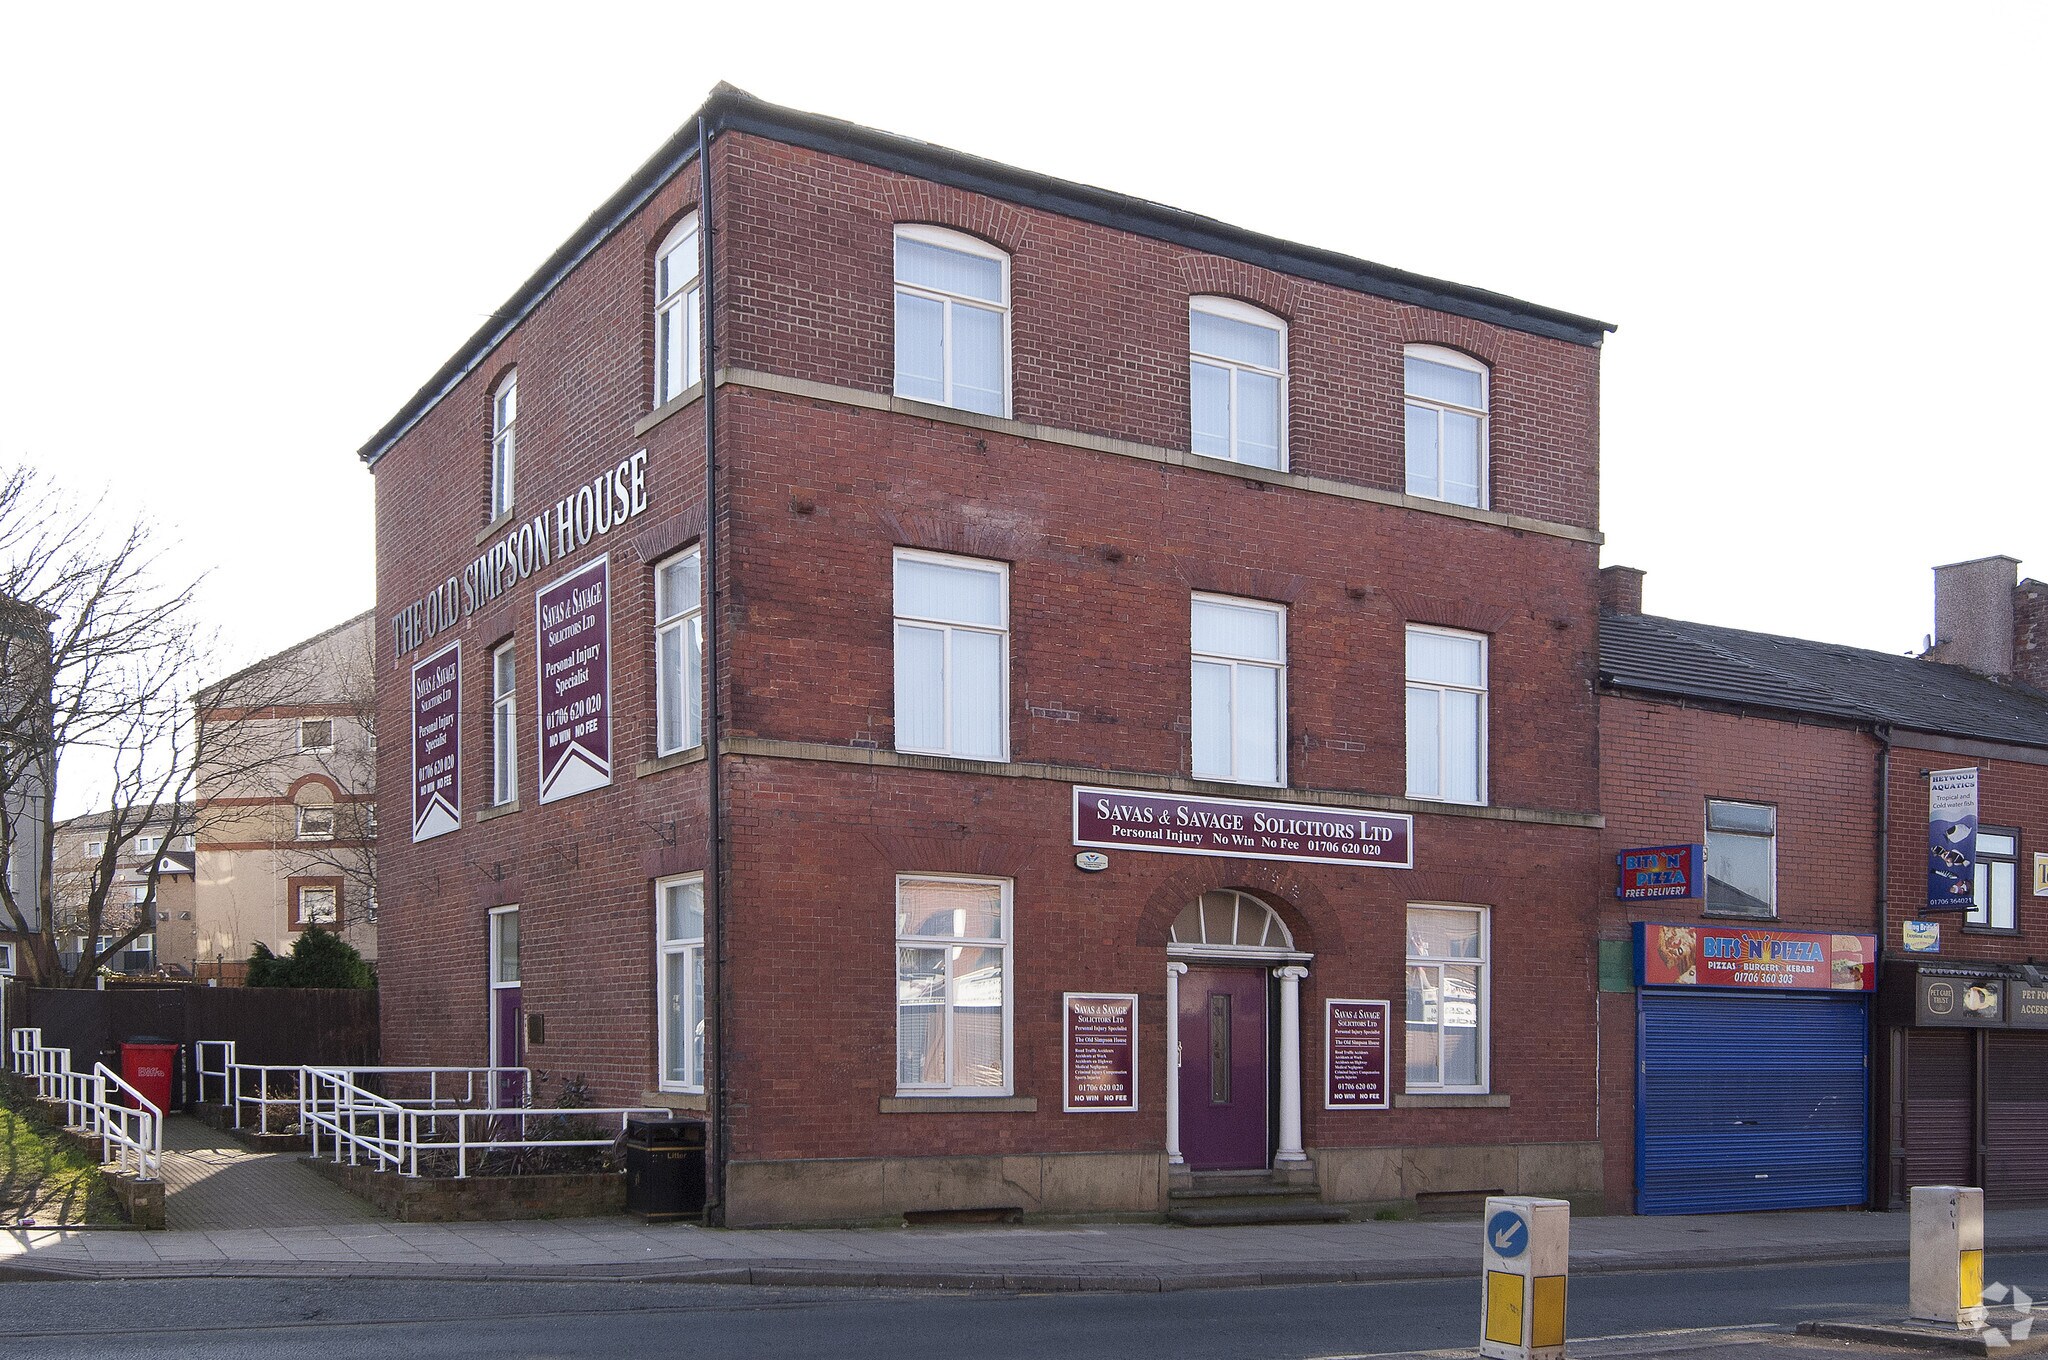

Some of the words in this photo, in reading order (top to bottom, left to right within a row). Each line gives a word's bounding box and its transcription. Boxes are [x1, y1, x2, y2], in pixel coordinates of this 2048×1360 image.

[392, 600, 422, 658] THE
[426, 576, 459, 638] OLD
[464, 510, 550, 616] SIMPSON
[556, 448, 647, 558] HOUSE
[566, 599, 571, 619] &
[546, 651, 574, 678] Personal
[576, 643, 600, 665] Injury
[556, 667, 589, 696] Specialist
[546, 706, 568, 730] 01706
[570, 700, 584, 721] 620
[586, 693, 601, 714] 020
[419, 718, 438, 738] Personal
[438, 714, 454, 730] Injury
[550, 734, 558, 747] NO
[559, 728, 571, 744] WIN
[575, 723, 585, 738] NO
[586, 718, 598, 734] FEE
[426, 732, 446, 754] Specialist
[418, 763, 434, 782] 01706
[434, 759, 443, 775] 620
[444, 754, 454, 771] 020
[1932, 774, 1974, 782] HEYWOOD
[444, 774, 452, 786] FEE
[1932, 782, 1975, 791] AQUATICS
[1097, 798, 1153, 824] SAVAS
[1158, 810, 1170, 825] &
[1176, 806, 1244, 830] SAVAGE
[1254, 812, 1354, 840] SOLICITORS
[1112, 824, 1163, 840] Personal
[1166, 830, 1203, 845] Injury
[1213, 833, 1228, 844] No
[1232, 834, 1255, 846] Win
[1262, 836, 1277, 848] No
[1280, 838, 1299, 850] Fee
[1308, 840, 1339, 853] 01706
[1342, 842, 1360, 854] 620
[1362, 844, 1381, 856] 020
[1626, 854, 1658, 870] BITS
[1636, 870, 1686, 886] PIZZA
[1626, 889, 1645, 898] FREE
[1648, 886, 1686, 896] DELIVERY
[1704, 936, 1742, 959] BITS
[1770, 941, 1824, 962] PIZZA
[1708, 962, 1736, 970] PIZZAS
[1744, 963, 1778, 972] BURGERS
[1786, 965, 1815, 973] KEBABS
[1734, 973, 1759, 983] 01706
[1760, 974, 1776, 983] 360
[1778, 974, 1793, 984] 303
[2022, 990, 2036, 1000] PET
